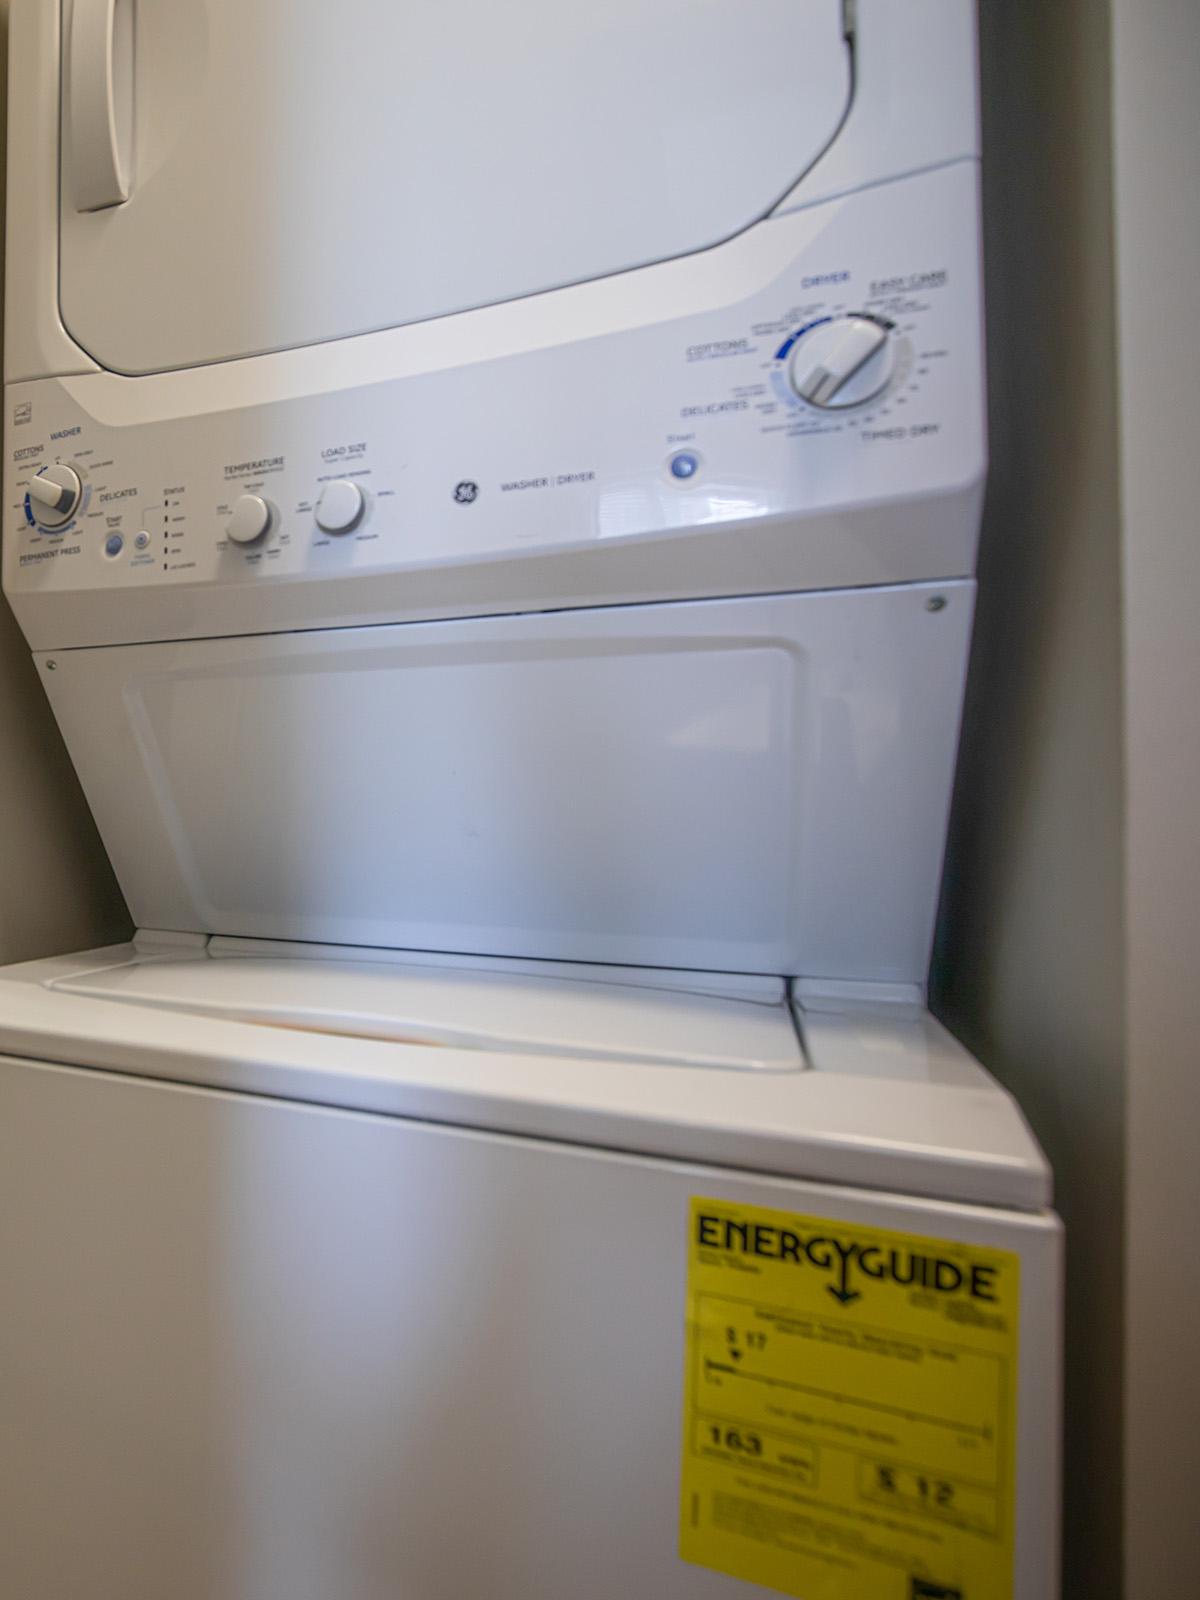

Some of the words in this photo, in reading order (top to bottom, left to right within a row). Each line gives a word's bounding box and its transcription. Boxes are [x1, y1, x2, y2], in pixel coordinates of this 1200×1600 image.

[802, 271, 850, 290] DRYER
[50, 426, 81, 440] WASHER
[13, 445, 45, 458] COTTONS
[321, 446, 346, 458] LOAD
[347, 442, 366, 453] SIZE
[224, 456, 285, 474] TEMPERATURE
[501, 477, 548, 492] WASHER
[557, 471, 596, 485] DRYER
[99, 488, 138, 503] DELICATES
[19, 549, 59, 563] PERMANENT
[60, 546, 81, 556] PRESS
[697, 1214, 1000, 1304] ENERGYGUIDE
